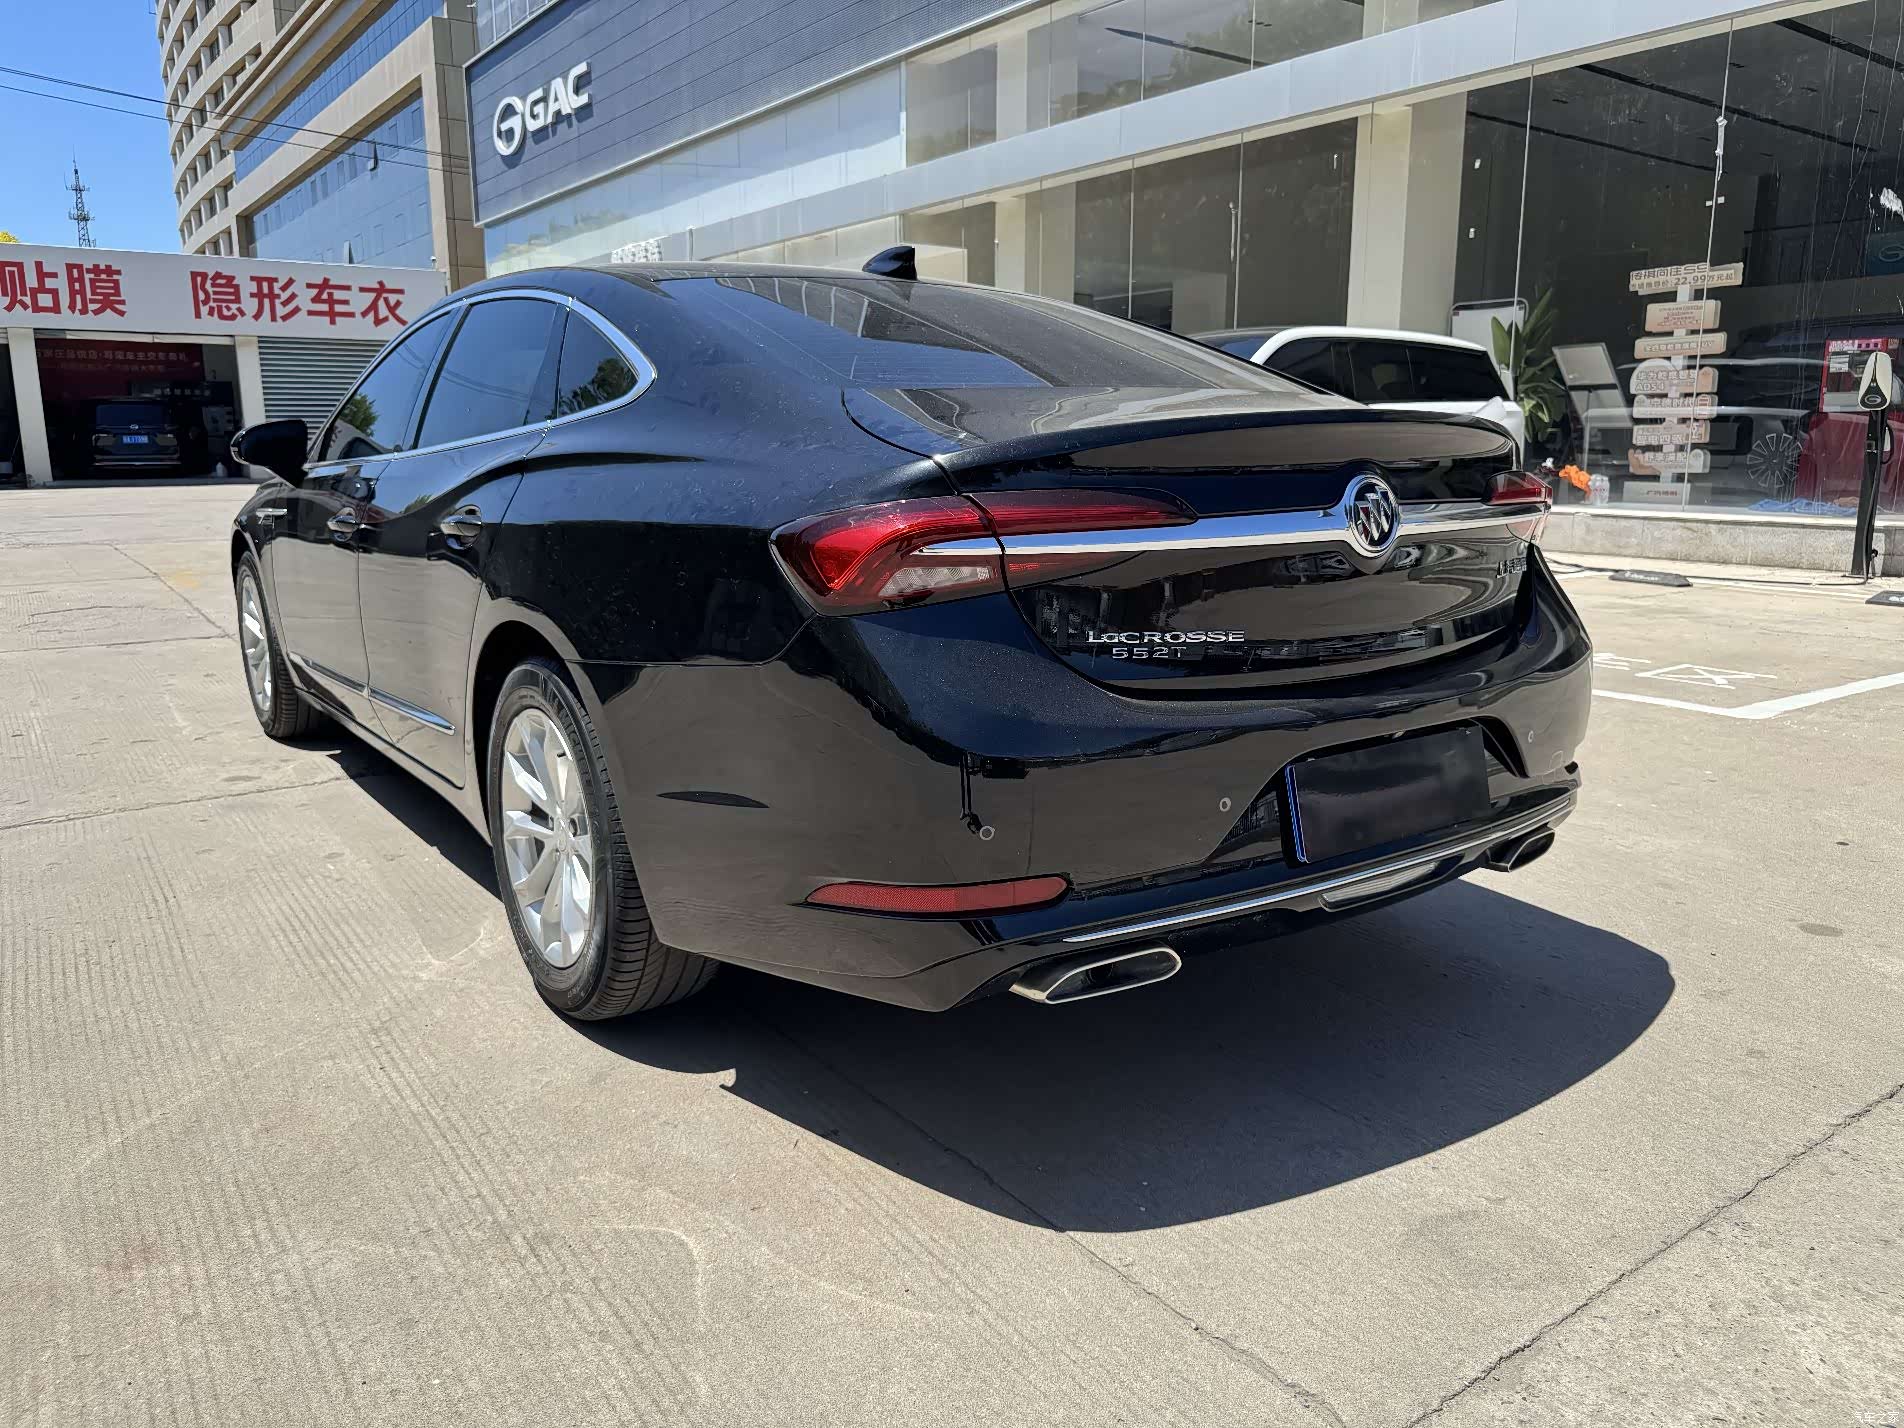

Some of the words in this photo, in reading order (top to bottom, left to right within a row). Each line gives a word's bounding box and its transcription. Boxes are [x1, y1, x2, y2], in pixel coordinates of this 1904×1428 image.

[525, 61, 590, 132] GAC
[0, 260, 128, 318] 贴膜
[190, 270, 409, 328] 隐形车衣
[1112, 646, 1187, 659] 552T
